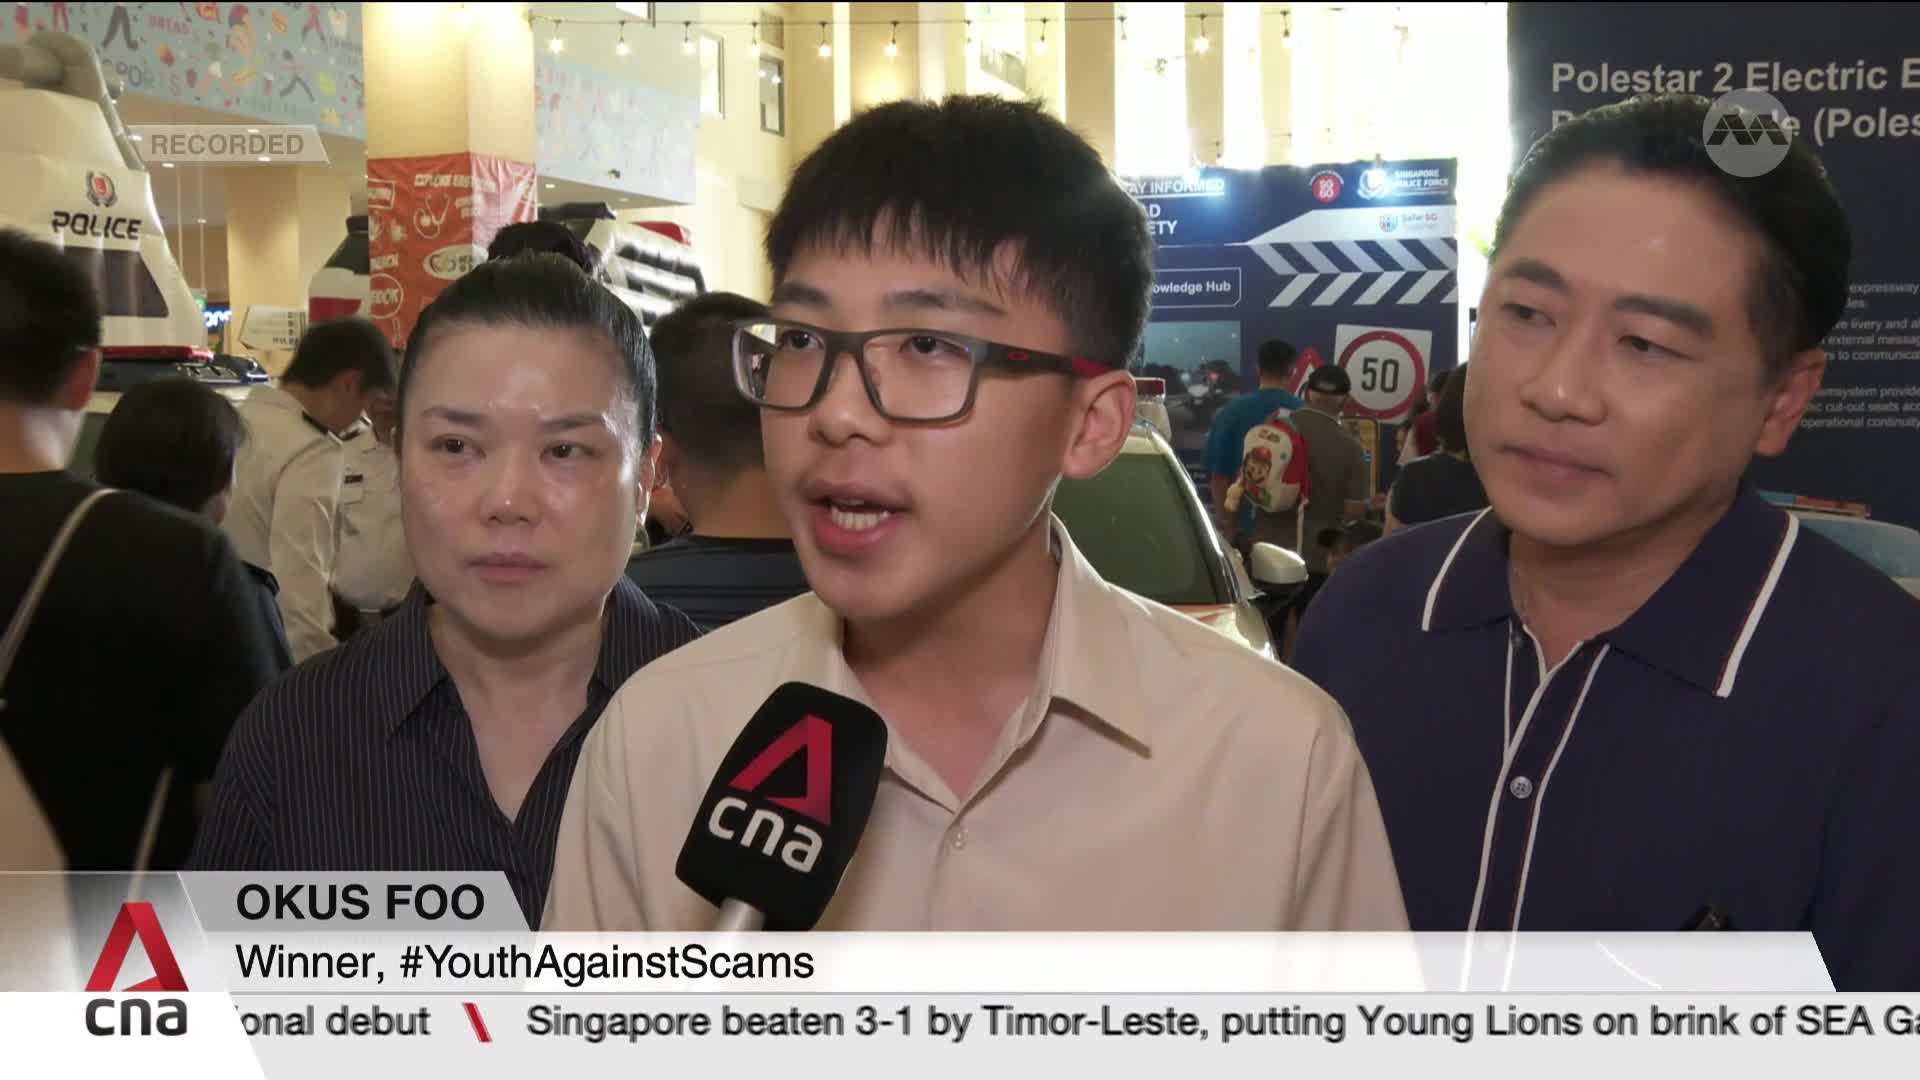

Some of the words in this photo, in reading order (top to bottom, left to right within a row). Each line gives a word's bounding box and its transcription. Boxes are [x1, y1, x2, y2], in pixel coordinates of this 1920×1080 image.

[1551, 62, 1702, 93] Polestar
[1712, 63, 1734, 92] 2
[1746, 60, 1888, 92] Electric
[1150, 179, 1224, 193] INFORMED
[51, 210, 142, 240] POLICE
[1151, 282, 1203, 295] owledge
[1206, 281, 1232, 292] Hub
[1886, 319, 1907, 329] and
[1361, 357, 1399, 394] 50
[708, 796, 823, 873] cna
